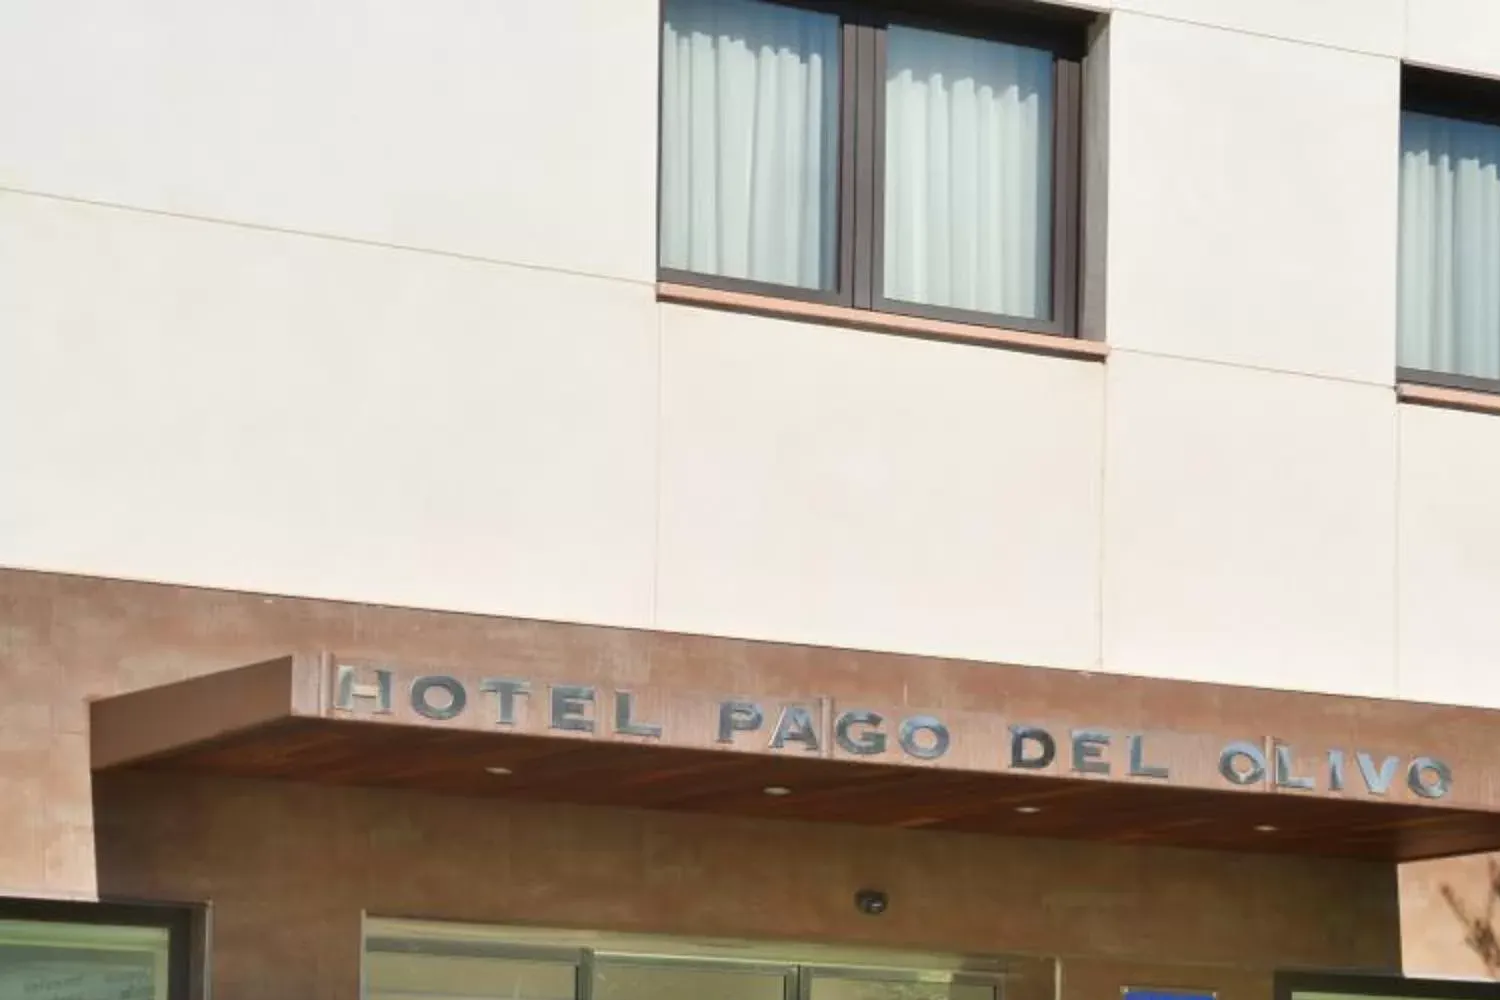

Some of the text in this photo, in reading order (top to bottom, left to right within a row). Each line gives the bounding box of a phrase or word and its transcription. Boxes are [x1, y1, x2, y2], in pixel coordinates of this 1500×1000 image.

[334, 663, 1454, 798] HOTEL PAGO DEL OLIVO
